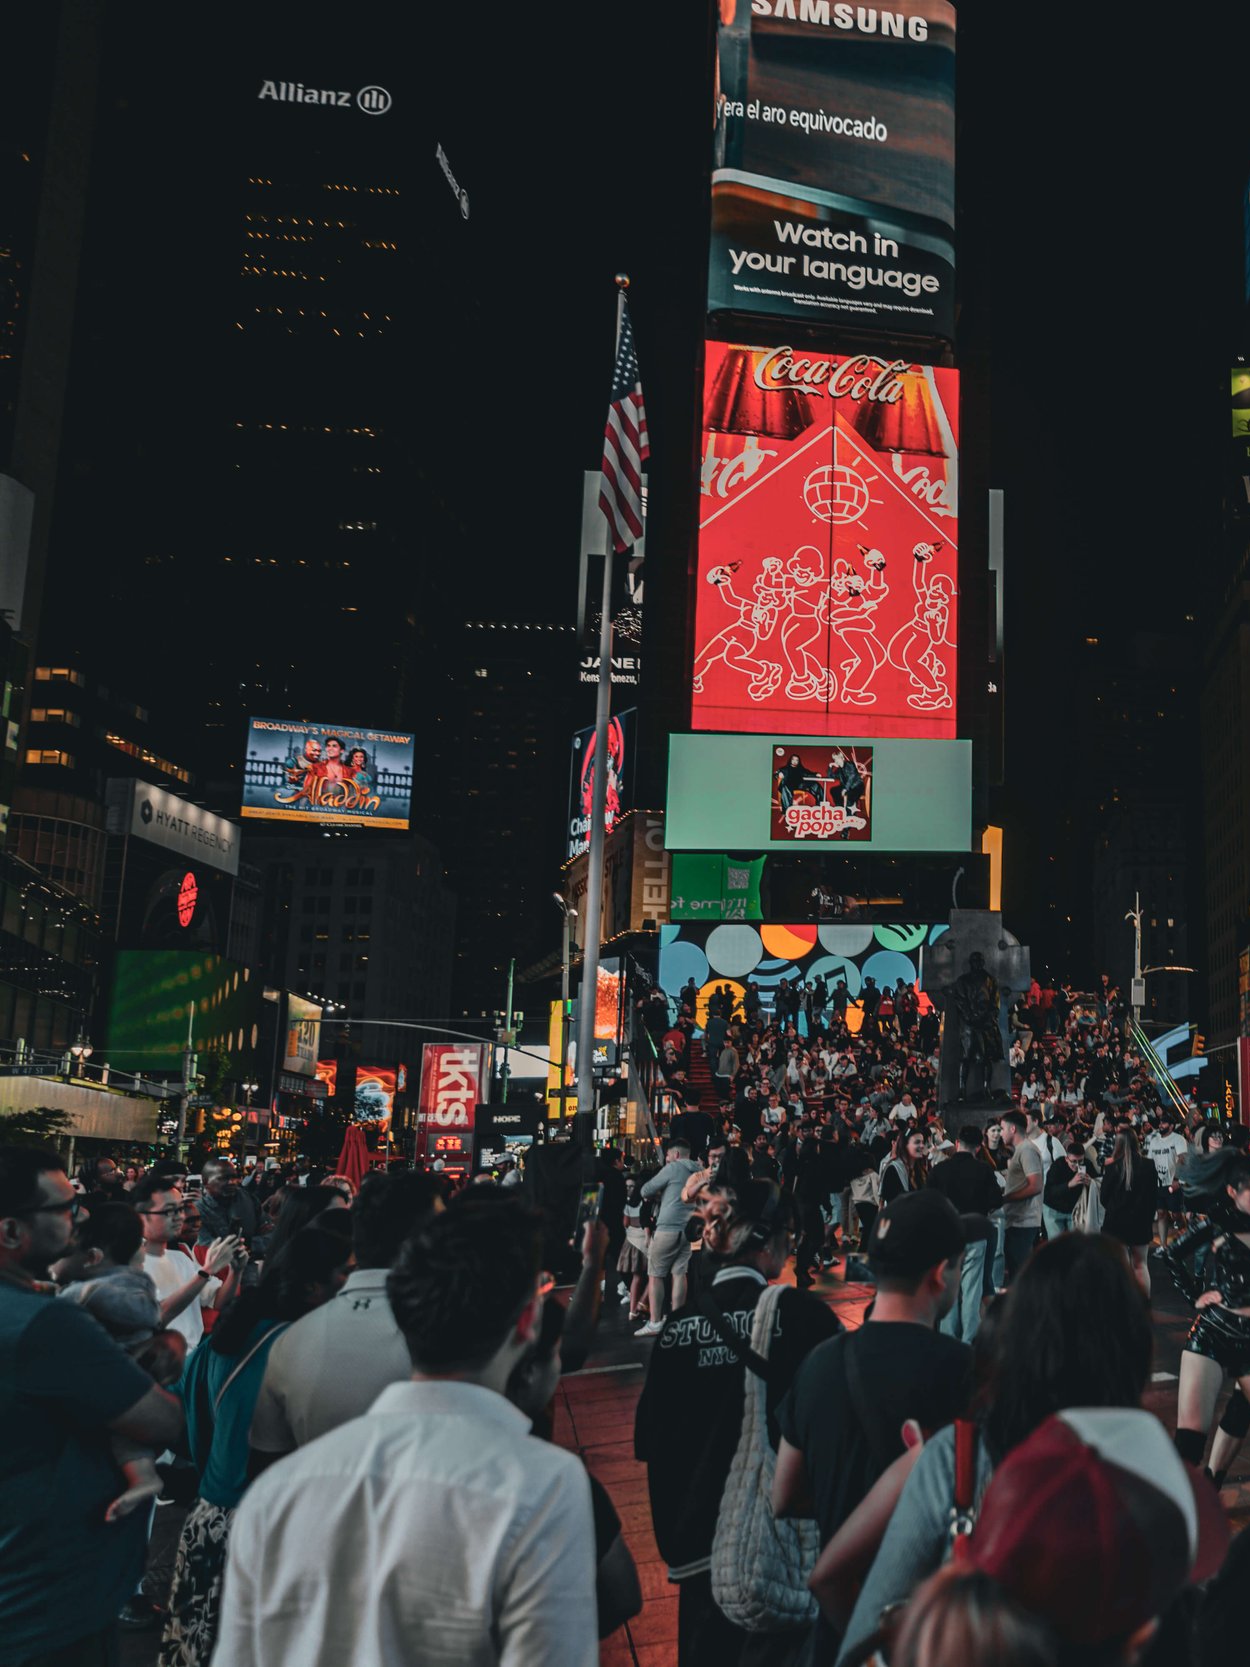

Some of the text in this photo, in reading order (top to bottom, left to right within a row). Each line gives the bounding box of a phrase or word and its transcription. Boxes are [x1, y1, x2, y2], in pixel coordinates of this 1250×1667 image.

[751, 0, 929, 42] SAMSUNG
[257, 80, 351, 108] Allianz
[724, 101, 743, 117] era
[747, 99, 760, 120] el
[762, 106, 786, 125] aro
[790, 109, 888, 142] equivocado
[774, 220, 899, 258] Watch in
[729, 249, 940, 297] your language
[253, 719, 411, 745] BROADWAY'S MAGICAL GETAWAY
[274, 775, 381, 811] Aladdin
[156, 811, 189, 836] HYATT
[787, 805, 844, 824] gacha
[797, 821, 833, 836] pop
[437, 1049, 480, 1126] tkts
